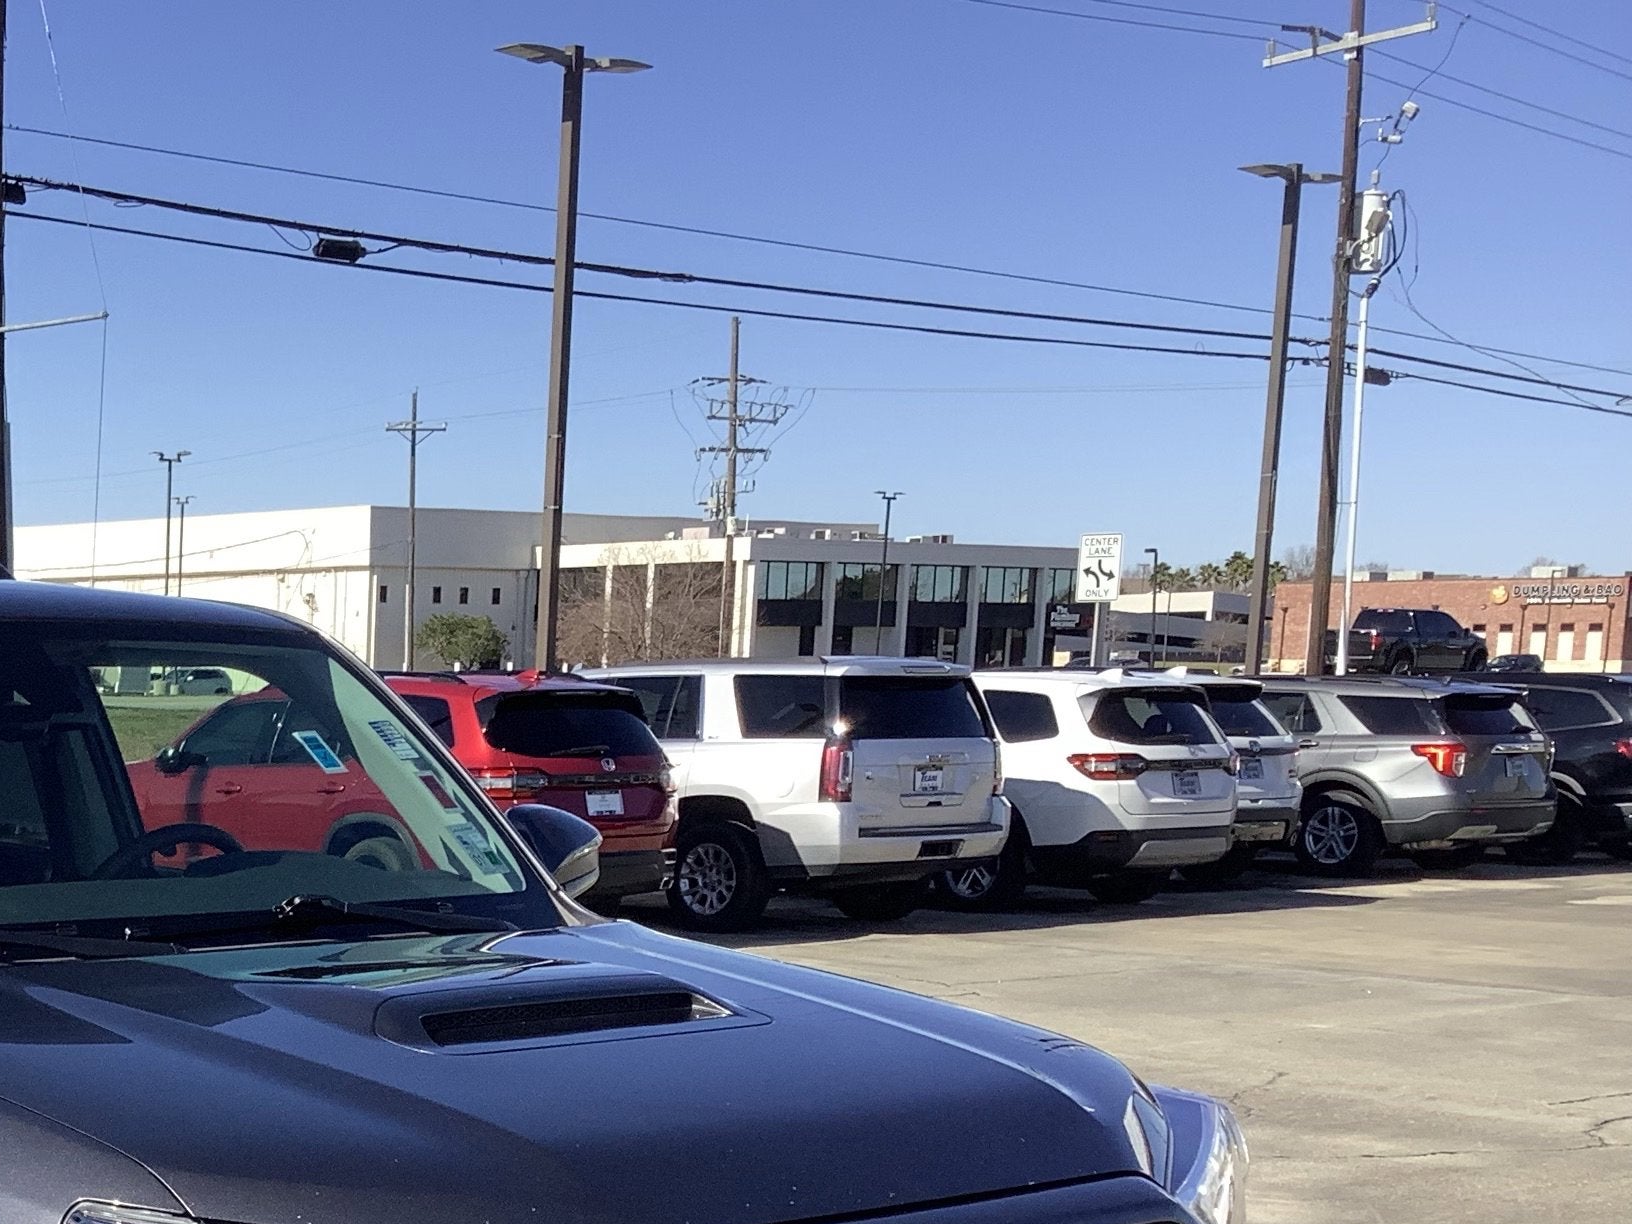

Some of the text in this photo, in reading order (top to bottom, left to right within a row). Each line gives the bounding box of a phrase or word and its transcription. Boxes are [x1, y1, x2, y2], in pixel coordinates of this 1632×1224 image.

[1084, 537, 1119, 546] CENTER
[1088, 546, 1113, 555] LANE
[1085, 589, 1109, 598] ONLY
[1596, 584, 1623, 596] BAO
